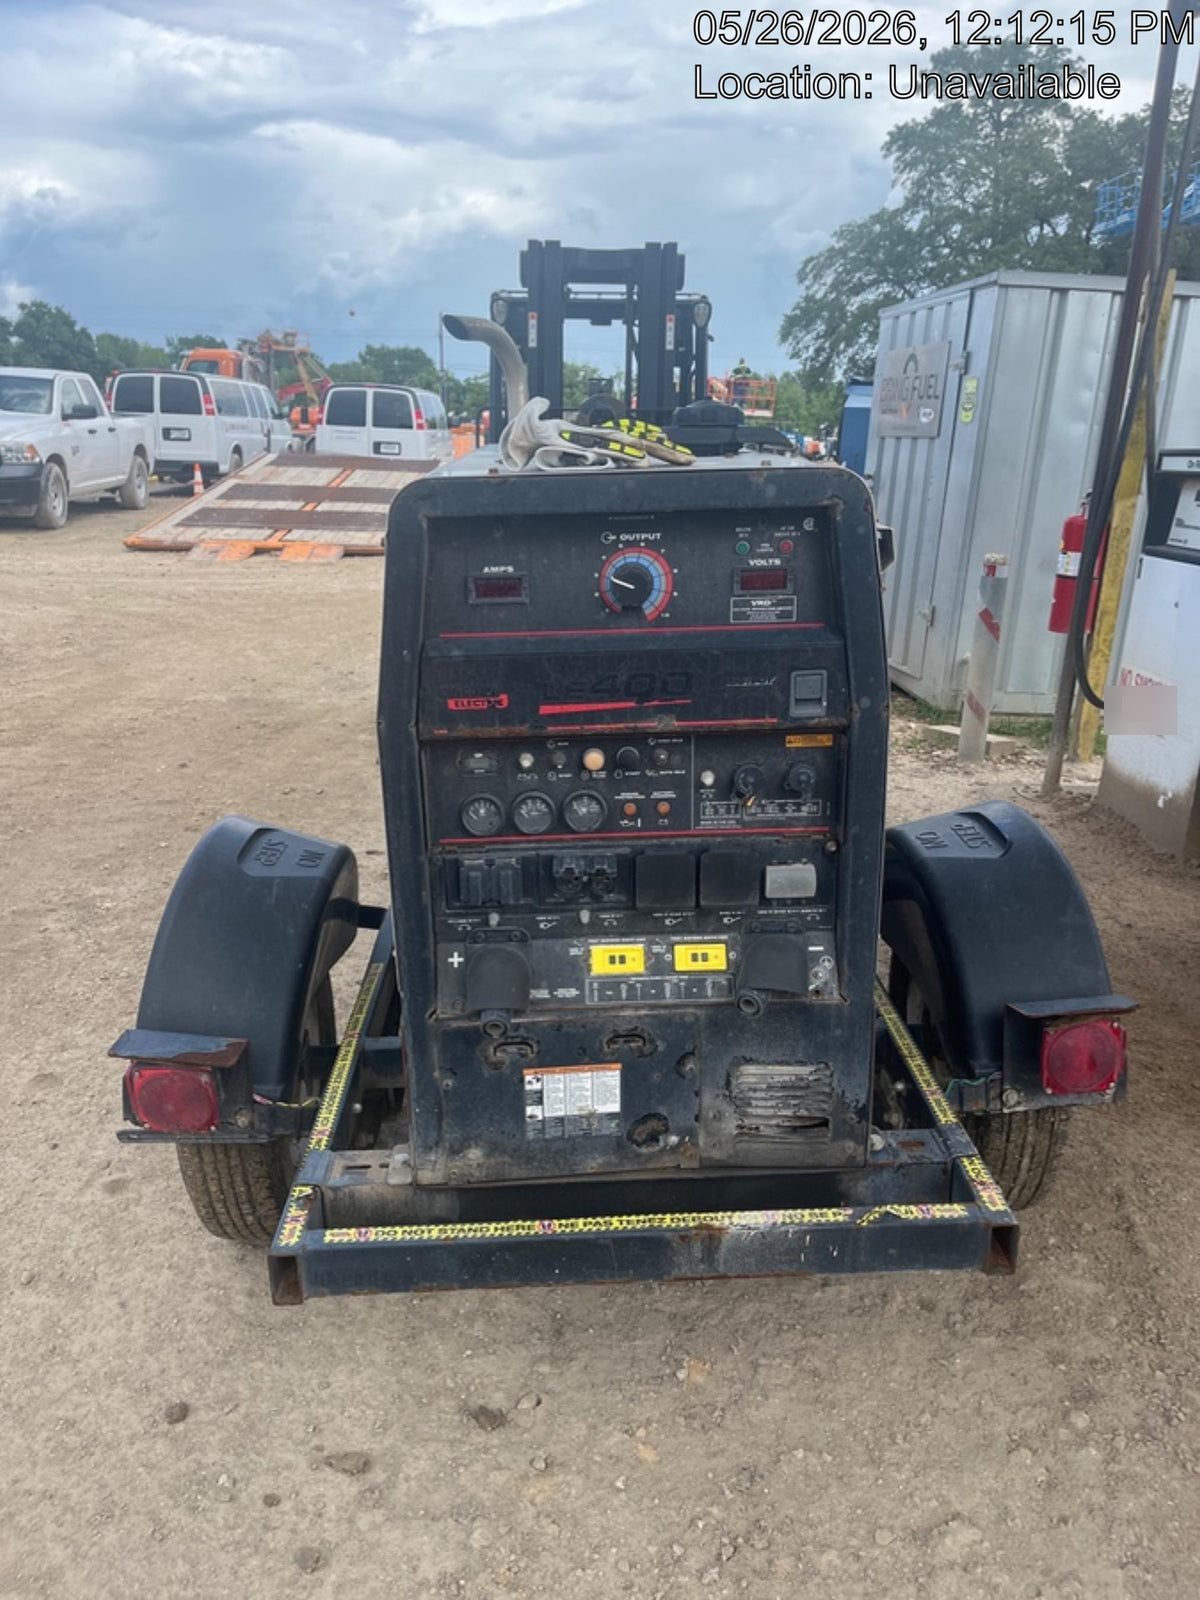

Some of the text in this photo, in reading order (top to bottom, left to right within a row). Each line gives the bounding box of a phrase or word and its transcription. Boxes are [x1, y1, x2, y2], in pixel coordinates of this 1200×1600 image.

[619, 533, 662, 541] OUTPUT
[748, 557, 782, 566] VOLTS
[483, 565, 514, 573] AMPS
[375, 1222, 535, 1237] DO NOT STAND HERE
